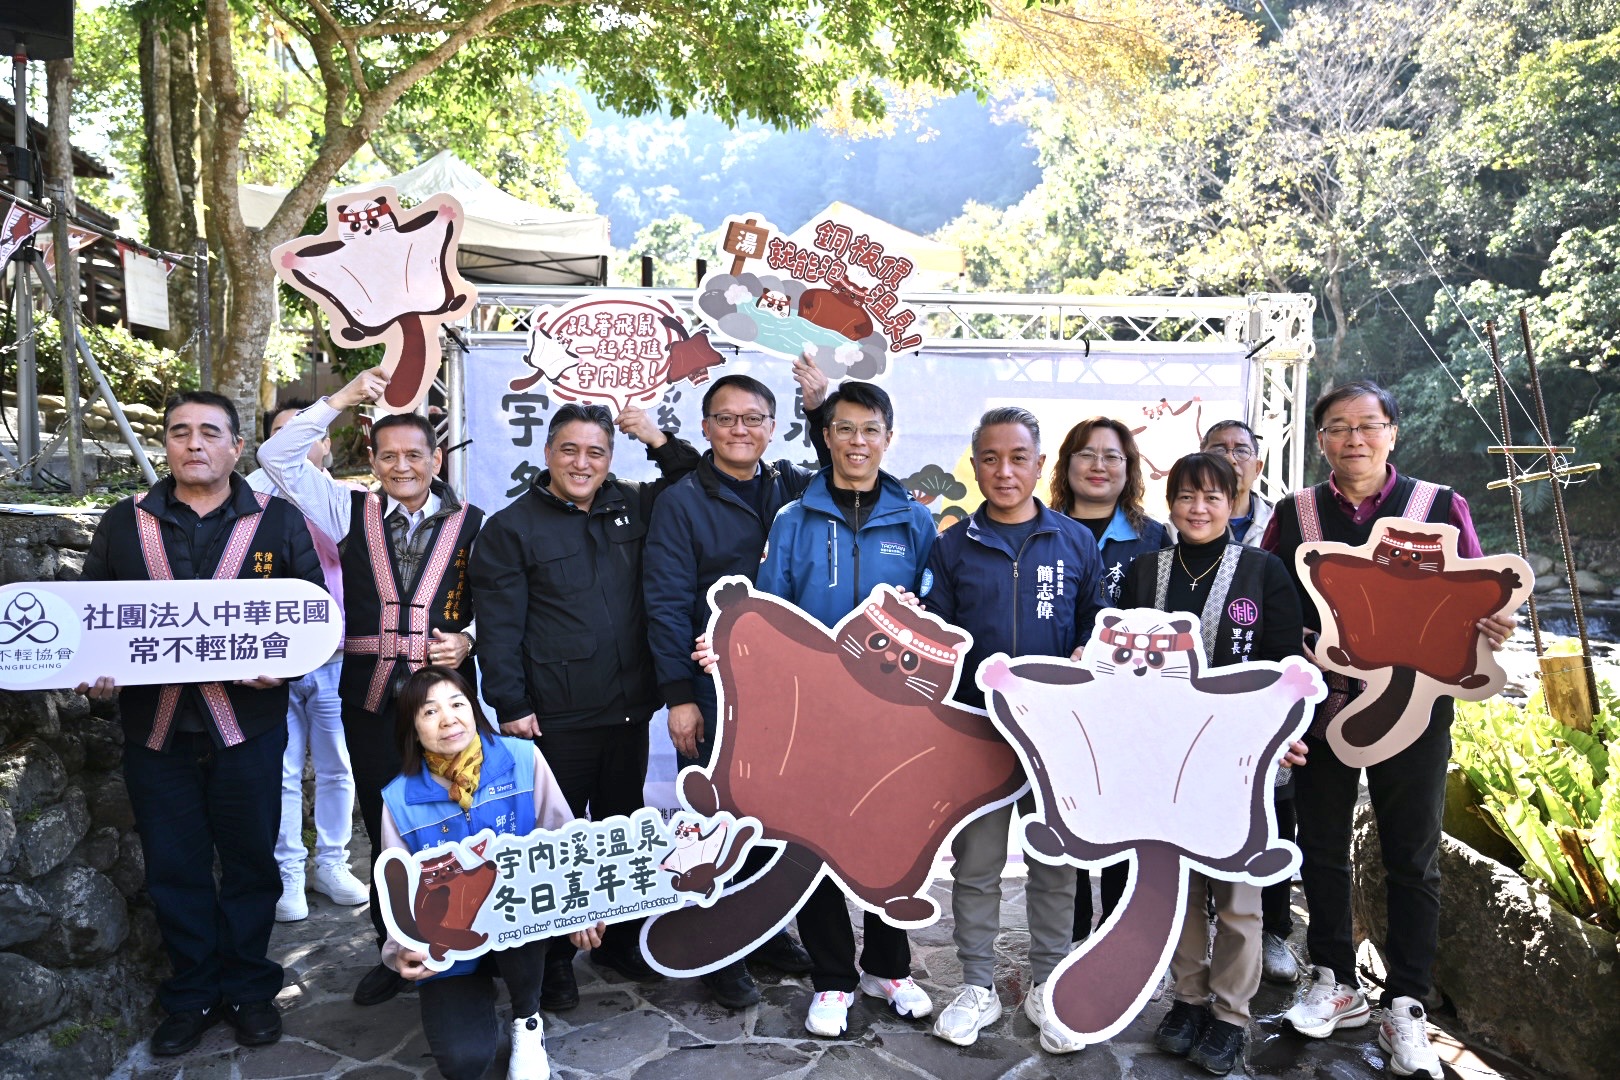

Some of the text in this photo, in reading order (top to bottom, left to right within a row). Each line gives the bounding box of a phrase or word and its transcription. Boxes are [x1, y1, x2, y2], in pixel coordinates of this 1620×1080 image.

[735, 230, 758, 254] 湯
[814, 220, 913, 290] 銅板價
[767, 237, 847, 286] 就能泡
[566, 313, 655, 338] 跟著飛鼠
[576, 339, 662, 361] 一起走進
[252, 551, 263, 573] 代表
[1036, 565, 1055, 620] 簡志偉
[82, 599, 330, 631] 社團法人中華民國
[128, 631, 291, 665] 常不輕協會
[1230, 627, 1243, 656] 里長
[509, 811, 518, 835] 立法
[494, 819, 668, 880] 宇內溪溫泉
[493, 856, 659, 923] 冬日嘉年華
[554, 915, 586, 929] Winter
[588, 903, 639, 921] Wonderland
[641, 894, 678, 910] Festival
